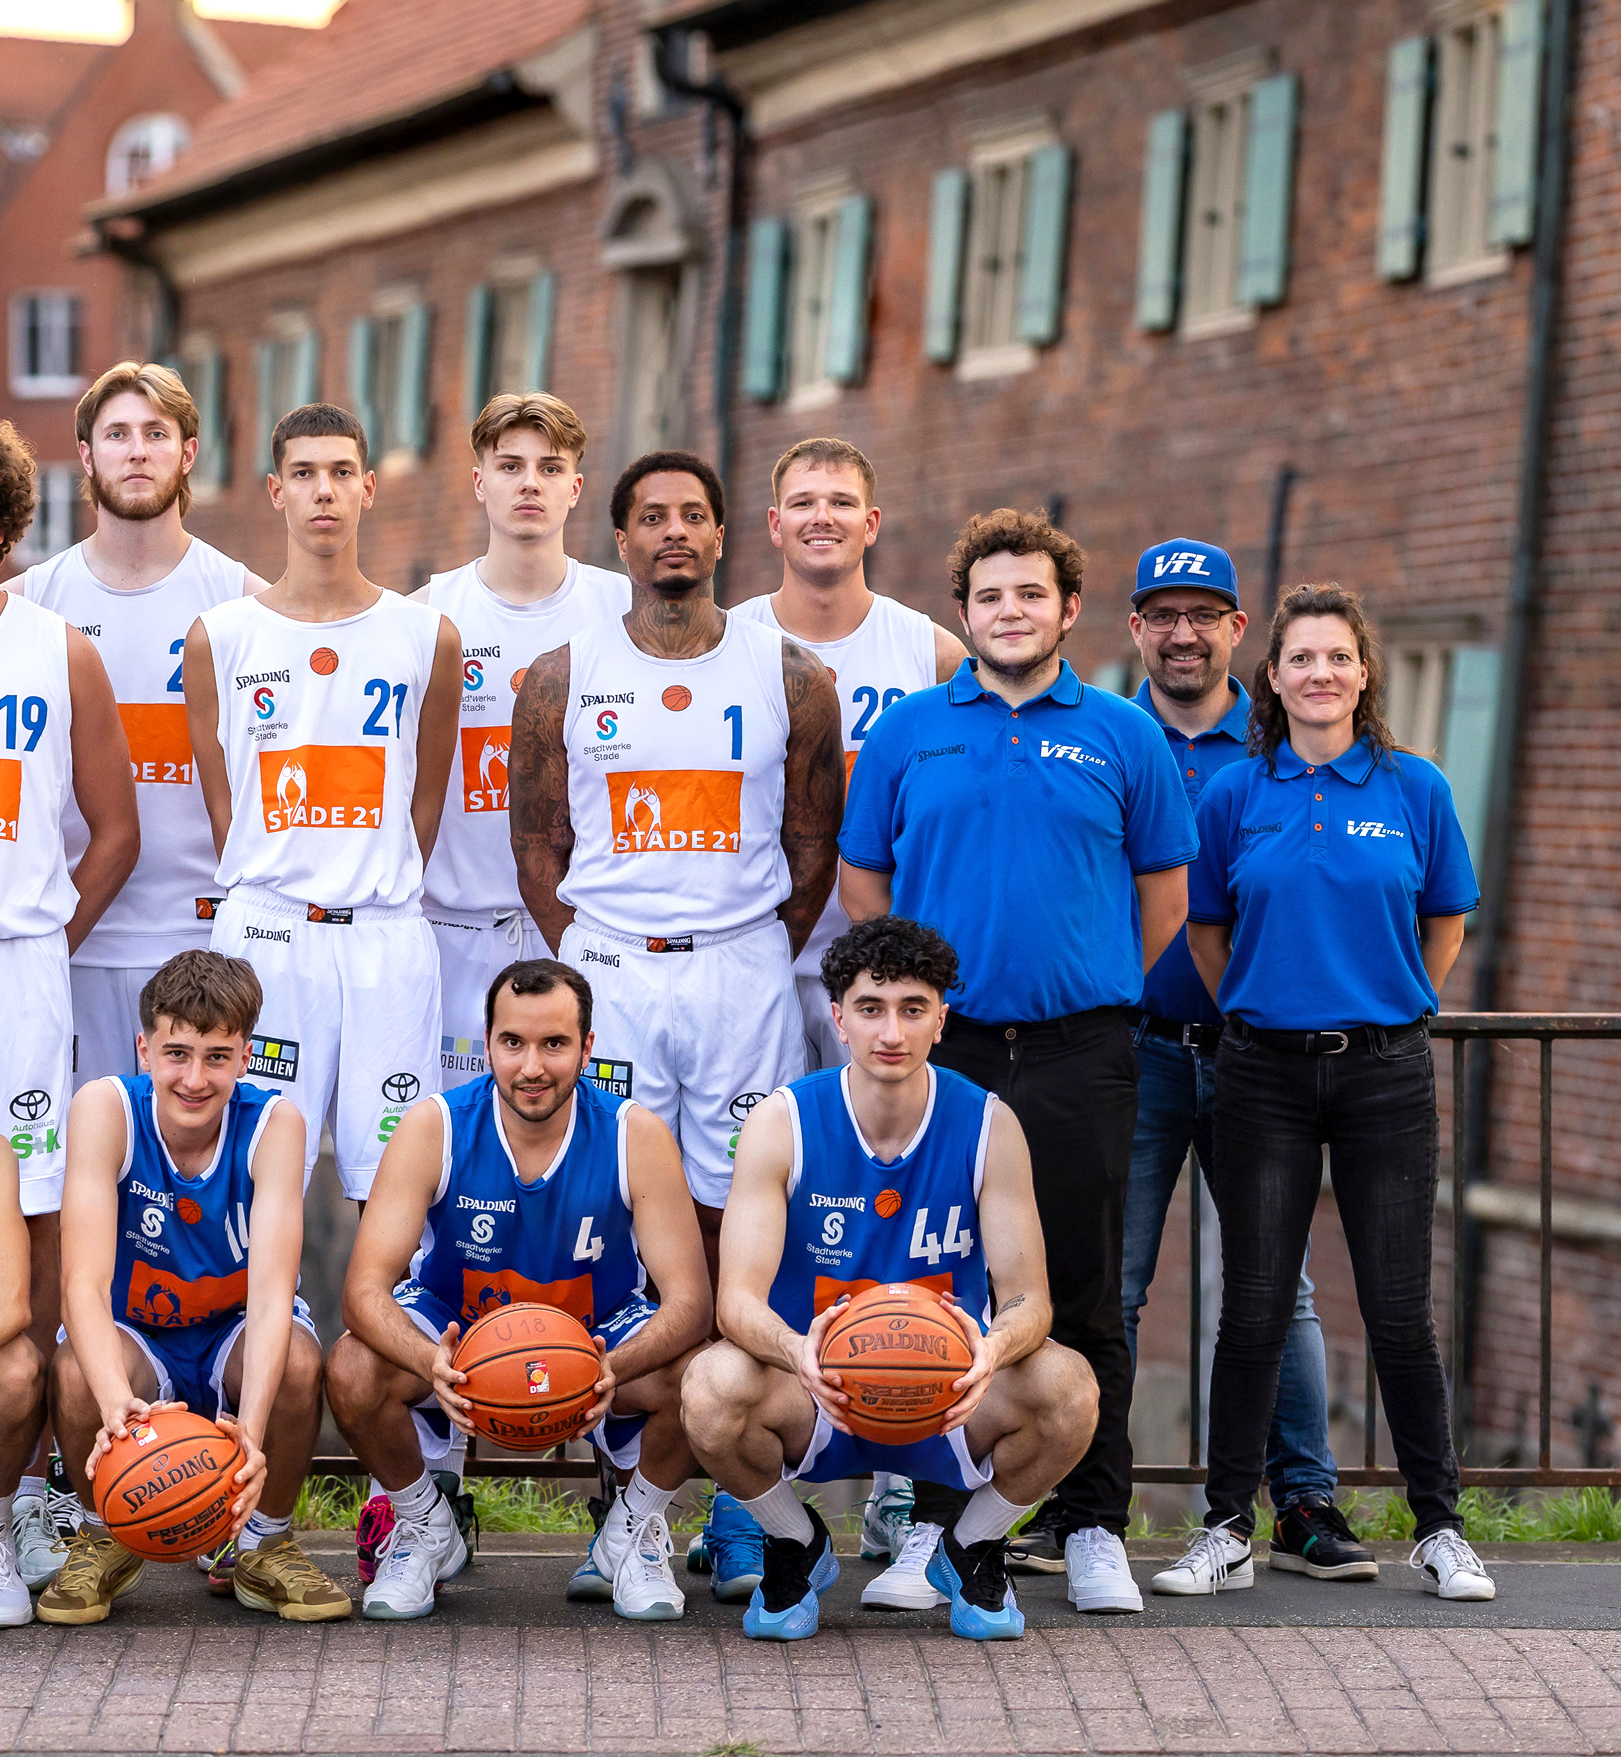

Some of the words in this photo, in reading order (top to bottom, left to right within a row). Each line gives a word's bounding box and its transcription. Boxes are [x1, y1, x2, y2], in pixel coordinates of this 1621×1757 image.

[236, 669, 290, 690] SPALDING
[362, 678, 409, 740] 21
[580, 692, 635, 708] SPALDING
[723, 705, 743, 760] 1
[583, 742, 632, 755] Stadtwerke
[593, 753, 620, 762] Stade
[918, 744, 965, 763] SPALDING
[1080, 753, 1106, 767] STADE
[162, 762, 191, 782] 21
[267, 805, 346, 830] STADE
[352, 806, 381, 827] 21
[616, 830, 706, 851] STADE
[712, 832, 739, 851] 21
[1239, 822, 1282, 841] SPALDING
[247, 1055, 295, 1078] OBILIEN
[440, 1053, 485, 1073] OBILIEN
[11, 1118, 55, 1133] Autohaus
[456, 1195, 516, 1213] SPALDING
[809, 1193, 867, 1213] SPALDING
[125, 1230, 171, 1255] Stadtwerke
[573, 1216, 605, 1262] 4
[909, 1205, 974, 1265] 44
[135, 1240, 158, 1258] Stade
[455, 1240, 503, 1255] Stadtwerke
[465, 1249, 491, 1263] Stade
[806, 1243, 853, 1259] Stadtwerke
[815, 1255, 841, 1266] Stade
[848, 1333, 949, 1361] SPALDING
[488, 1406, 585, 1438] SPALDING
[122, 1448, 218, 1515] SPALDING
